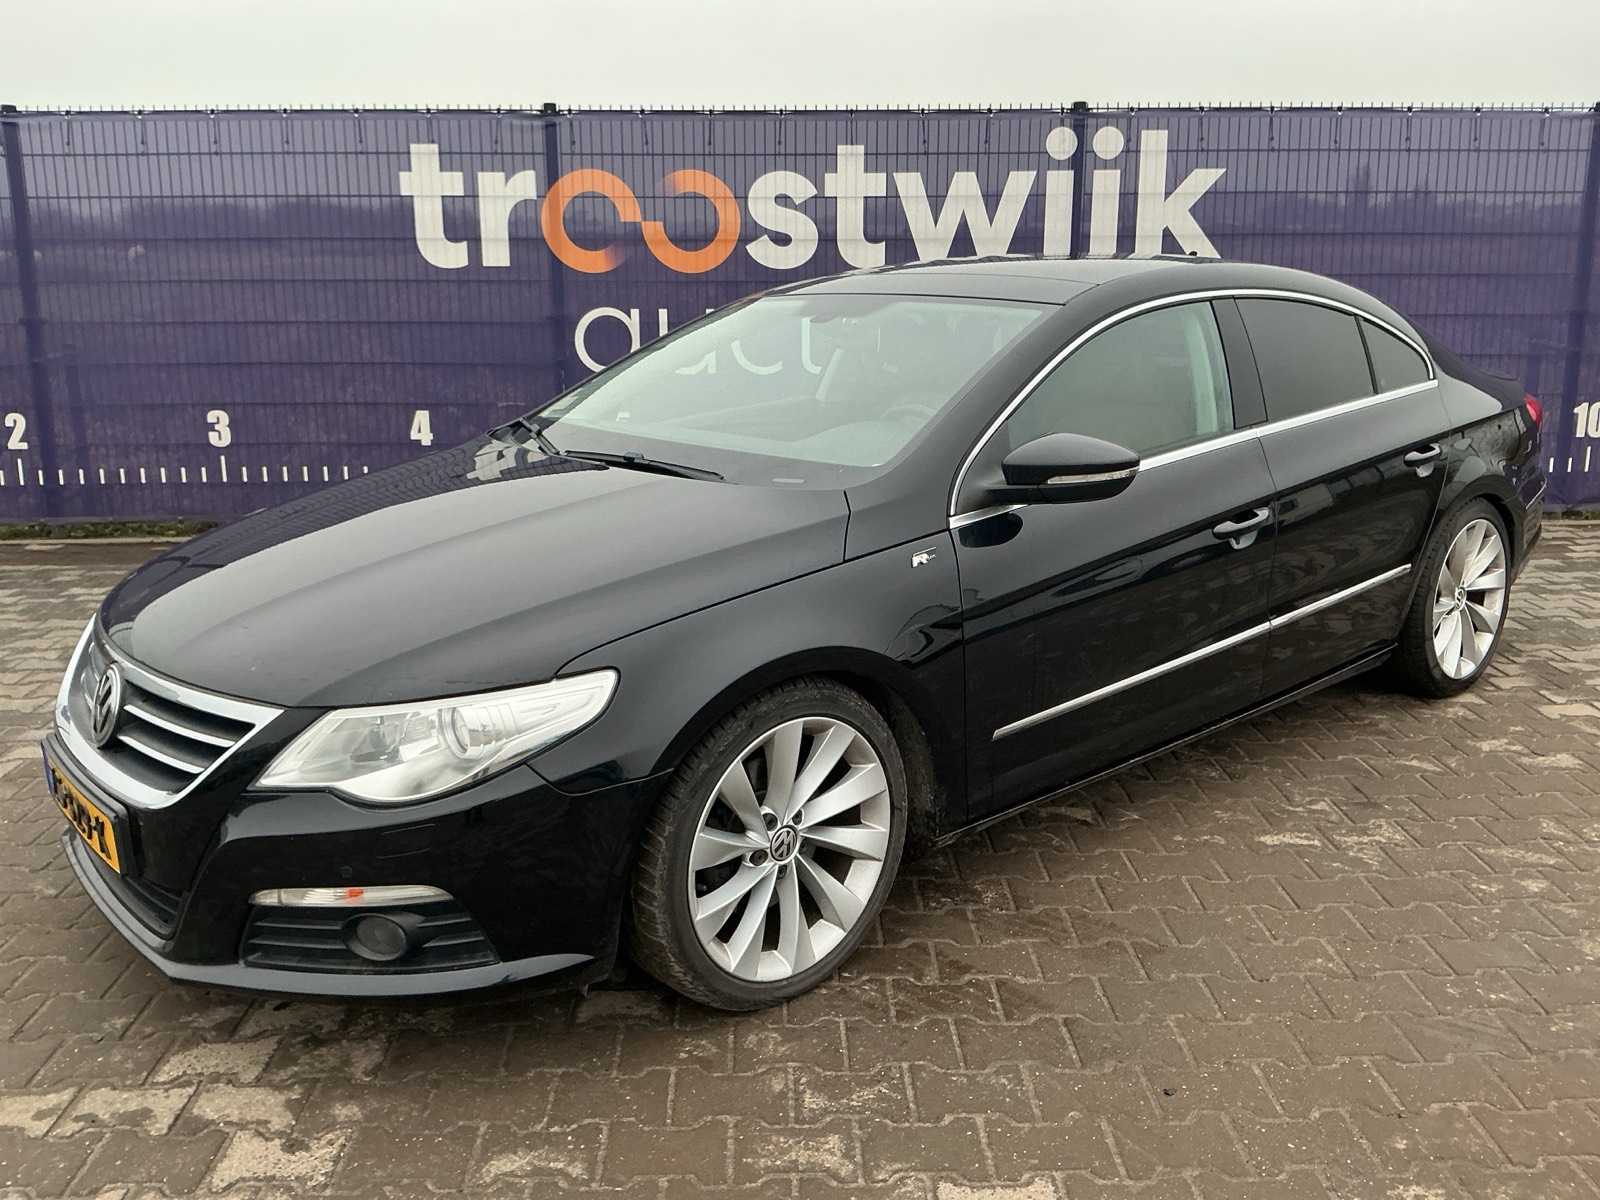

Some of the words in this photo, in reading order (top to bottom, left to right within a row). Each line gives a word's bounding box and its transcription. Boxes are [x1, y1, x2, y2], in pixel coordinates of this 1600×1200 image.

[5, 412, 28, 449] 2
[207, 409, 231, 447] 3
[410, 410, 433, 446] 4
